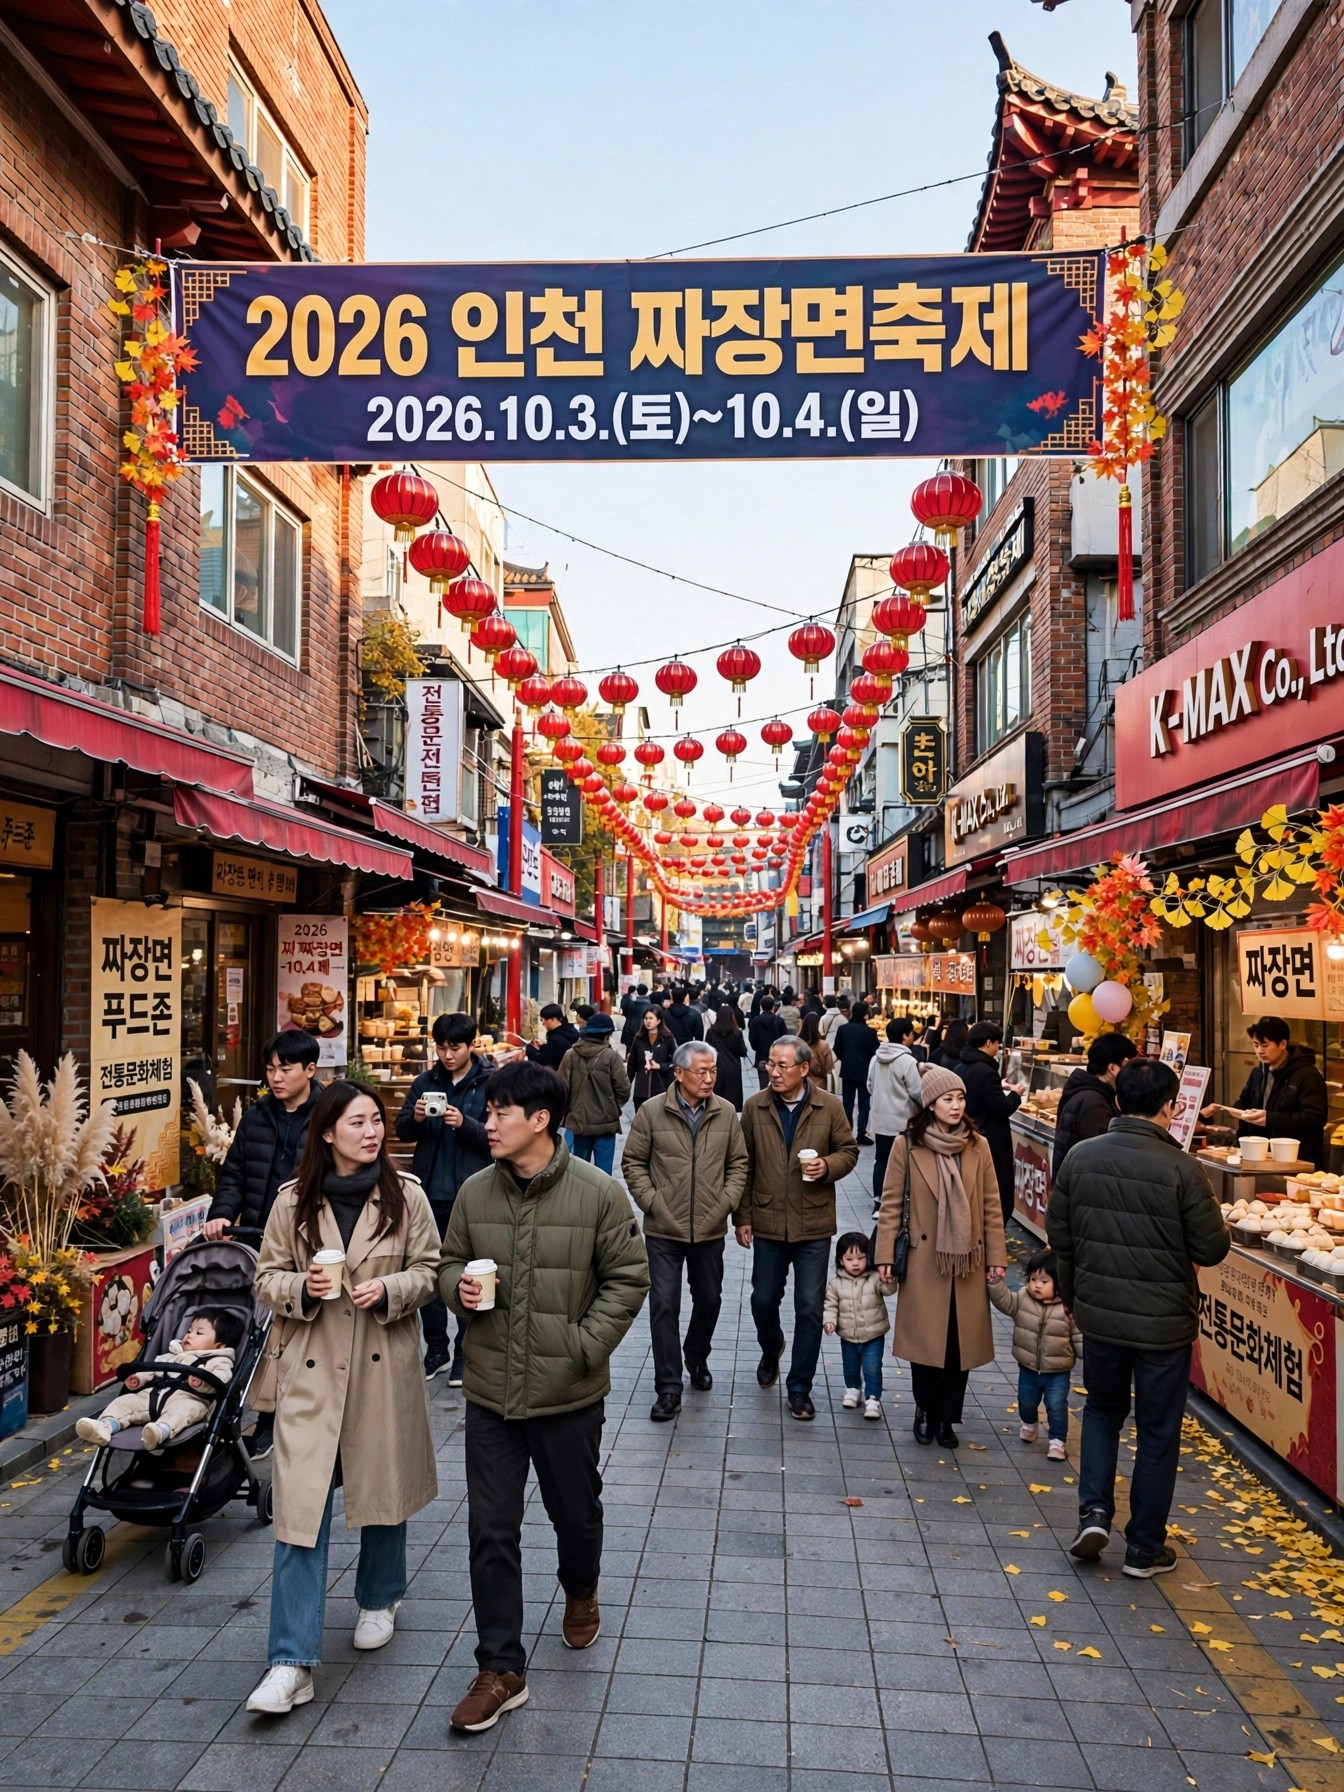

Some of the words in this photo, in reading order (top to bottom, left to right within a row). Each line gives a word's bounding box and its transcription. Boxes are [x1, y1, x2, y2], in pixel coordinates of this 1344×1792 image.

[246, 294, 428, 377] 2026
[455, 289, 603, 377] 인천
[631, 282, 1028, 375] 짜장면축제
[367, 389, 919, 445] 2026.10.3.(토)~10.4.(일)
[1151, 641, 1256, 759] K-MAX
[1260, 647, 1305, 706] Co.,
[101, 934, 173, 983] 짜장면
[294, 924, 328, 937] 2026
[1245, 942, 1316, 999] 짜장면
[101, 991, 173, 1040] 푸드존
[100, 1057, 174, 1090] 전통문화체험
[1198, 1292, 1303, 1403] 전통문화체험
